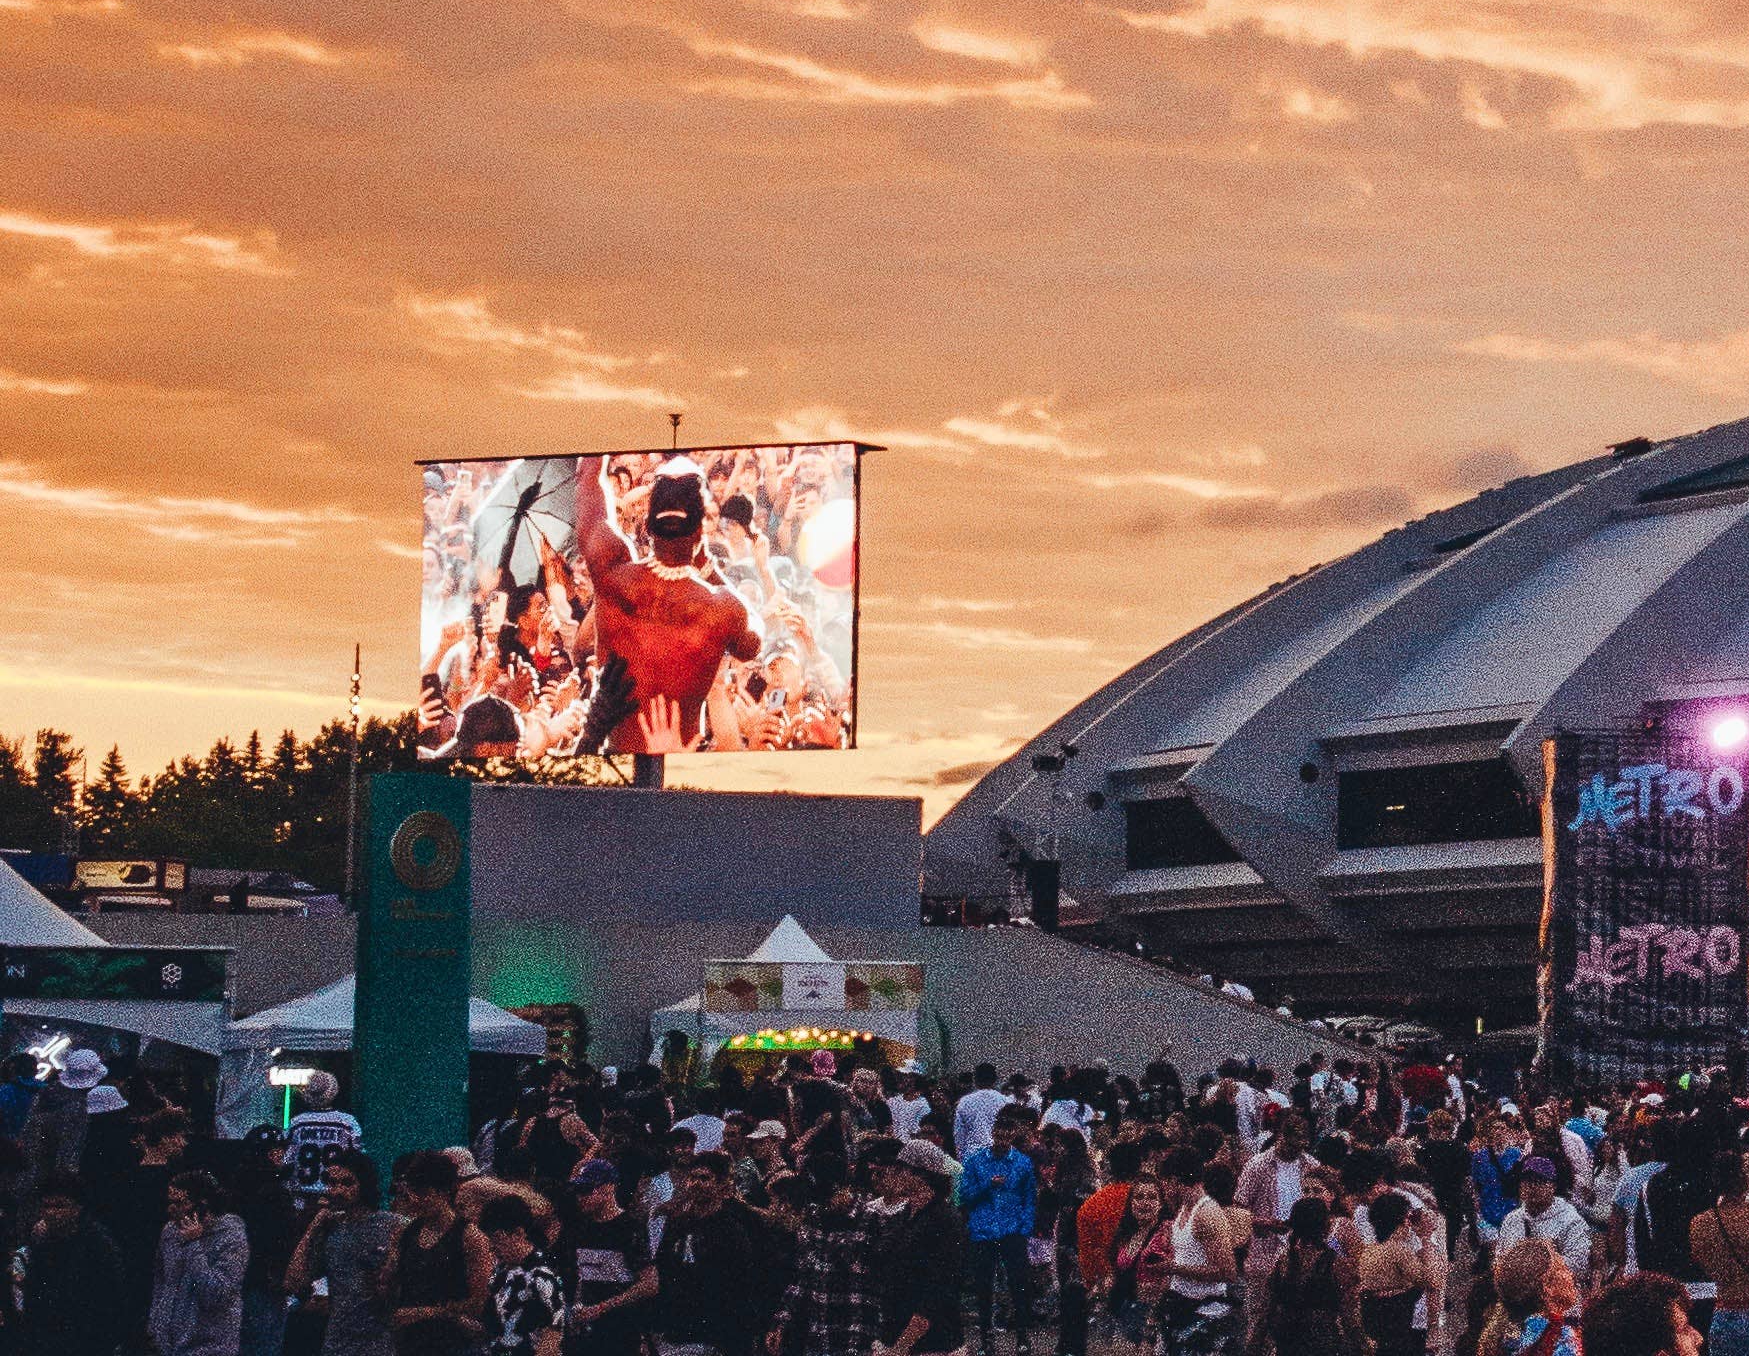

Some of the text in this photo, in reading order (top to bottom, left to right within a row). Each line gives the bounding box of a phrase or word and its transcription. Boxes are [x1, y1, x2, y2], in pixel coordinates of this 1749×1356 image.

[1566, 763, 1744, 832] METRO
[1576, 846, 1729, 871] FESTIVAL
[1564, 923, 1741, 993] METRO
